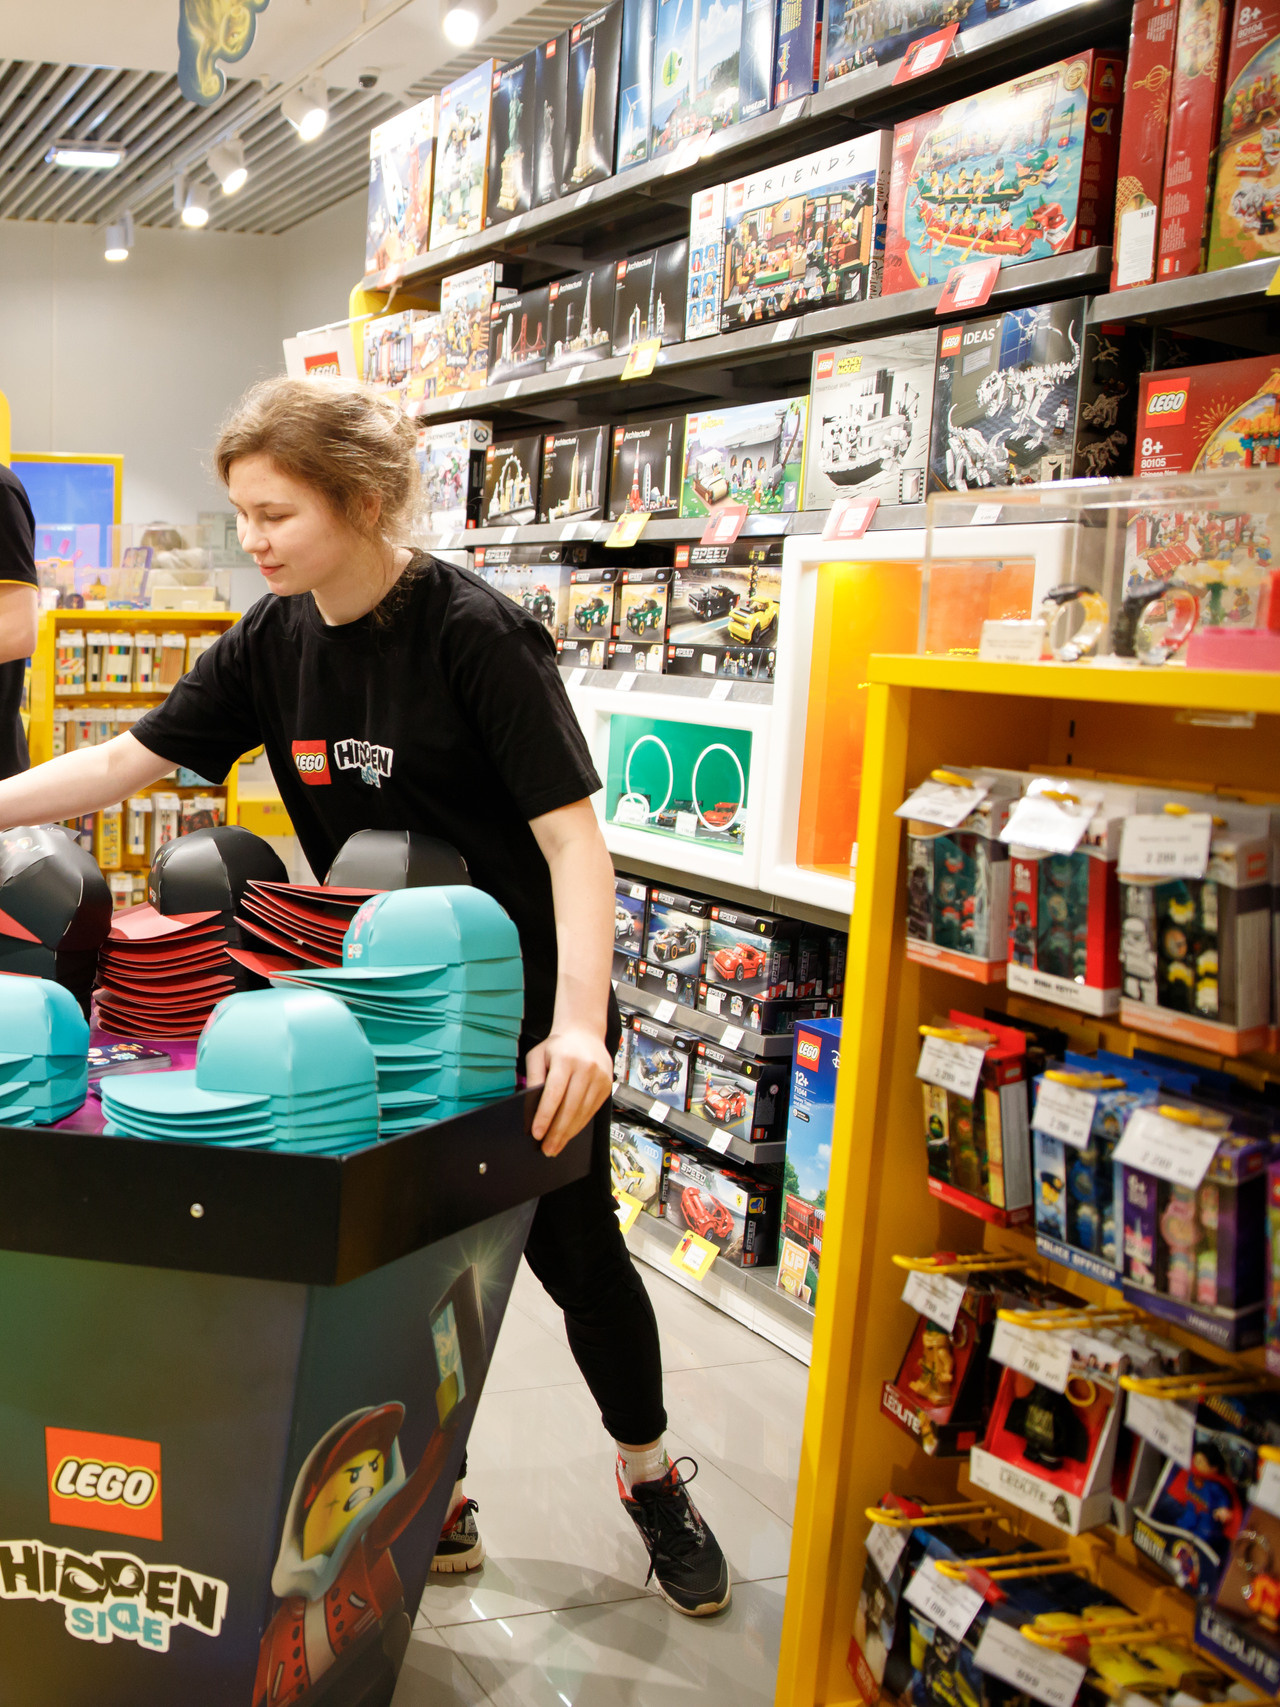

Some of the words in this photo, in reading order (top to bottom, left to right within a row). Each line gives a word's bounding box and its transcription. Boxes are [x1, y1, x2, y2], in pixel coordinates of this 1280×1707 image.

[1239, 6, 1262, 26] 8+
[501, 63, 524, 79] Architecture
[742, 98, 767, 115] Vestas
[896, 132, 913, 147] LEGO
[893, 160, 904, 171] 8+
[627, 257, 653, 272] Architecture
[559, 280, 583, 293] Architecture
[500, 300, 522, 312] Architecture
[941, 336, 961, 349] LEGO
[963, 328, 996, 346] IDEAS
[818, 360, 833, 371] LEGO
[837, 356, 863, 367] MICKEY
[837, 364, 862, 375] MOUSE
[1148, 391, 1186, 413] LEGO
[553, 437, 578, 448] Architecture
[624, 430, 651, 442] Architecture
[495, 446, 515, 456] Architecture
[1141, 438, 1163, 456] 8+
[1141, 458, 1167, 469] 80105
[691, 547, 729, 559] SPEED
[295, 754, 326, 771] LEGO
[705, 1048, 725, 1063] SPEED
[798, 1042, 819, 1060] LEGO
[795, 1071, 809, 1087] 12+
[794, 1085, 807, 1097] 71044
[681, 1163, 706, 1183] SPEED
[746, 1221, 756, 1250] SPEED
[784, 1249, 805, 1271] UP
[1038, 1240, 1070, 1261] POLICE
[1072, 1256, 1117, 1282] OFFICER
[883, 1391, 921, 1436] LEDLITE
[54, 1459, 156, 1507] LEGO
[999, 1468, 1048, 1502] LEDLITE
[450, 1530, 477, 1541] Reebok
[70, 1602, 163, 1647] SIDE
[1201, 1616, 1280, 1684] LEDLITE
